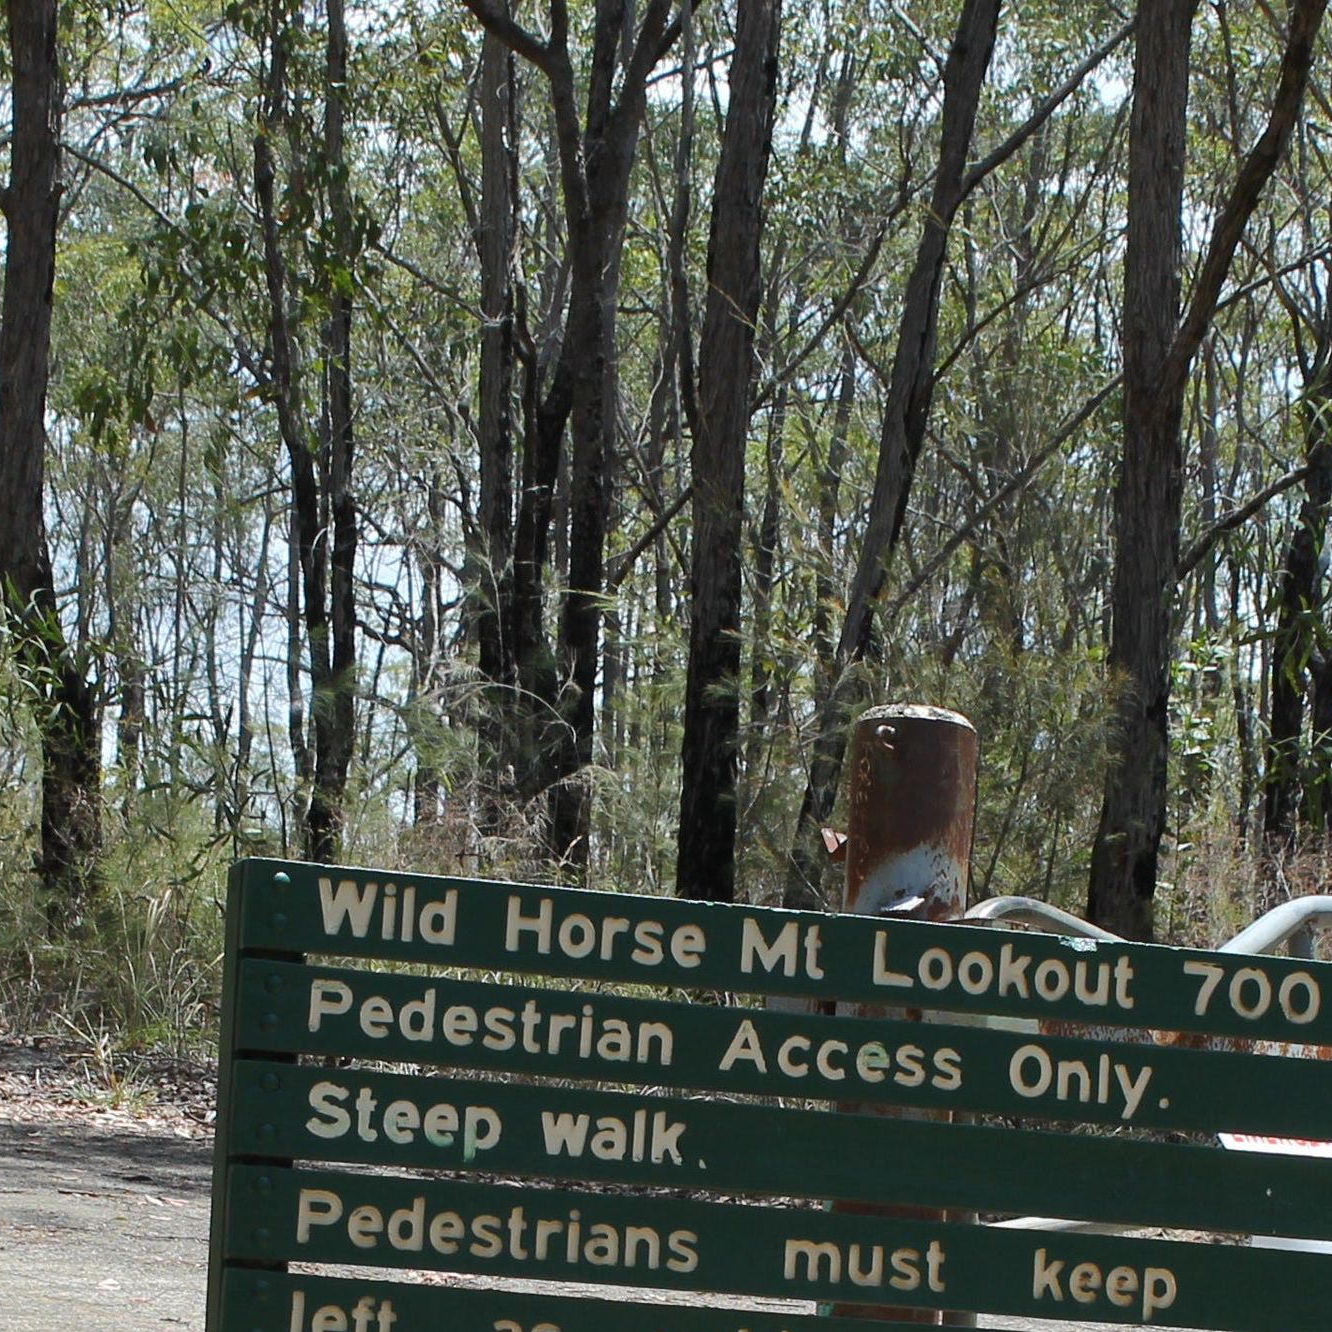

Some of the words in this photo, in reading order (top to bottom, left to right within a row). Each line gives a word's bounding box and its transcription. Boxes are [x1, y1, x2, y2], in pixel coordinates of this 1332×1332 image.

[318, 877, 458, 946] Wild
[505, 896, 707, 969] Horse
[739, 918, 825, 980] Mt
[872, 931, 1135, 1009] Lookout
[1182, 960, 1321, 1022] 700
[308, 980, 673, 1066] Pedestrian
[719, 1019, 962, 1091] Access
[1009, 1043, 1171, 1119] Only.
[305, 1081, 502, 1163] Steep
[296, 1188, 699, 1272] Pedestrians
[783, 1239, 946, 1293] must
[1031, 1248, 1178, 1321] keep
